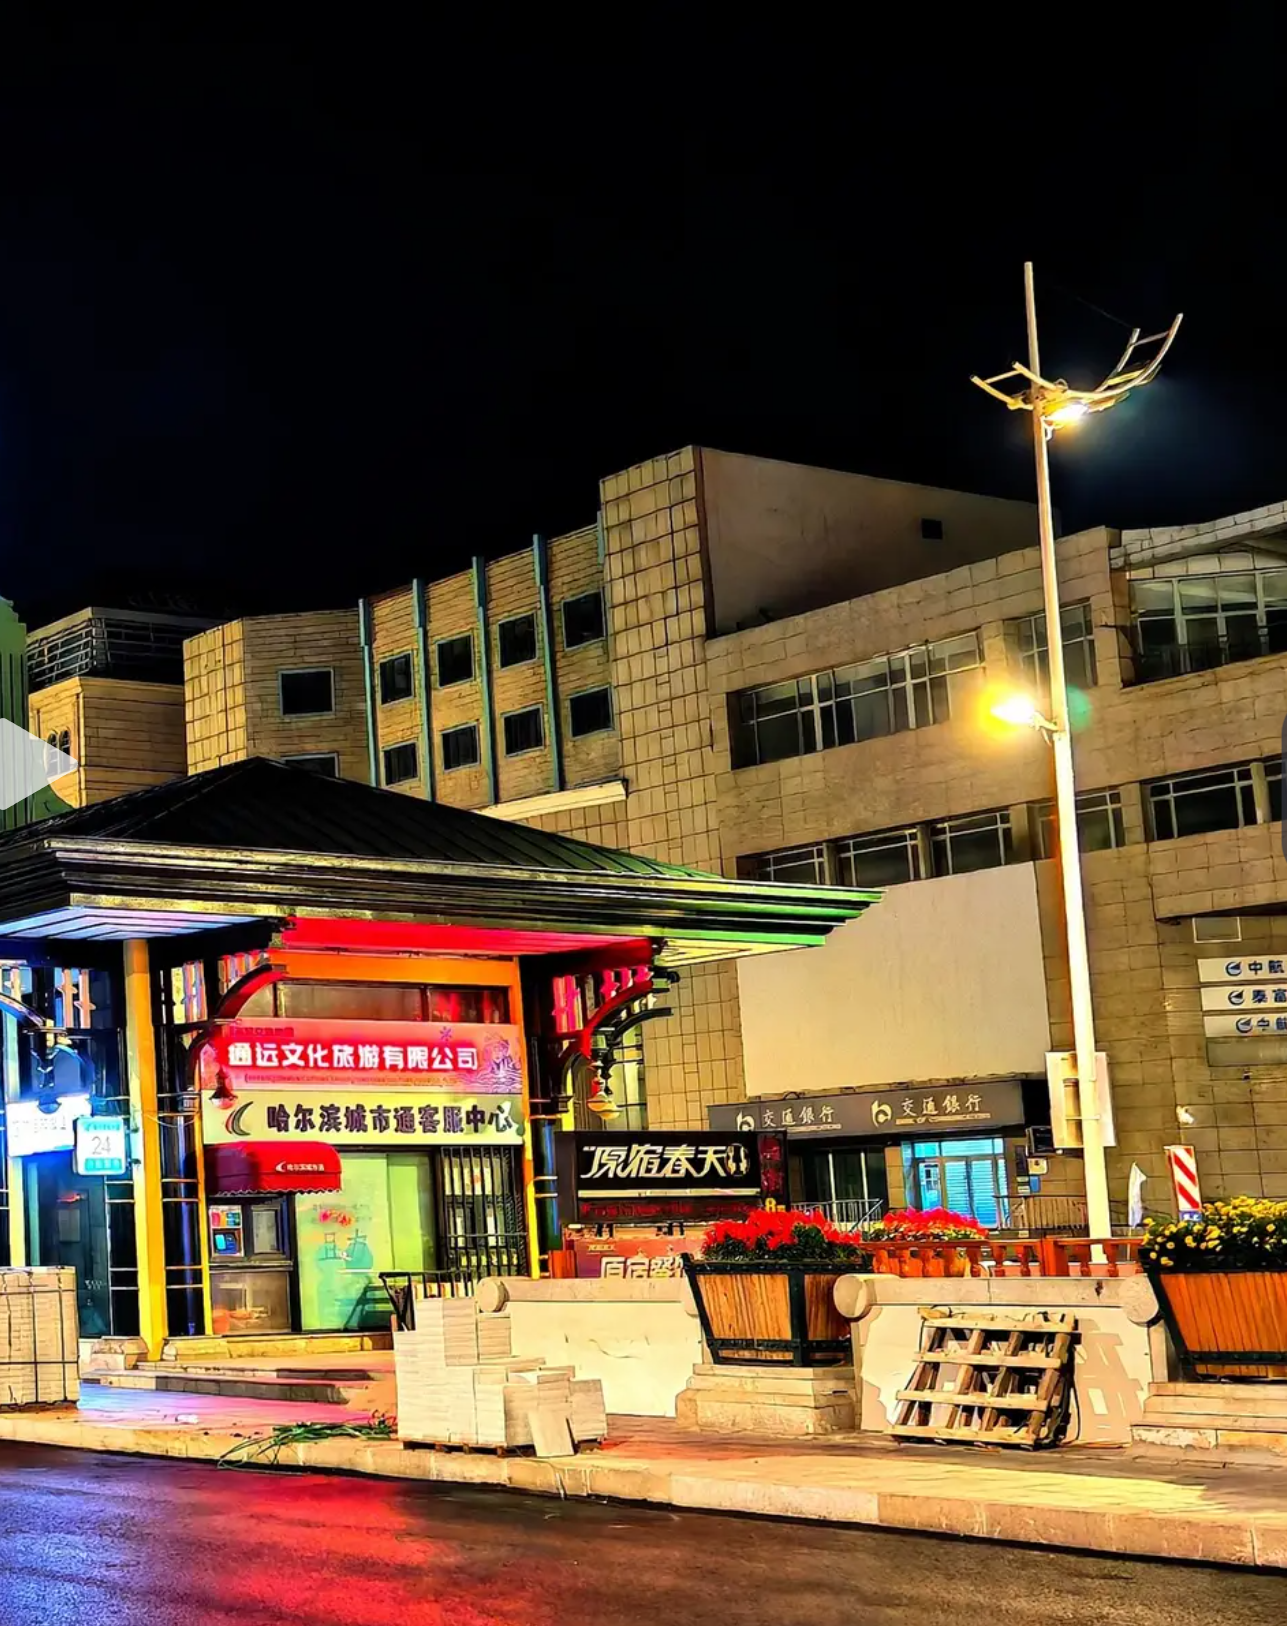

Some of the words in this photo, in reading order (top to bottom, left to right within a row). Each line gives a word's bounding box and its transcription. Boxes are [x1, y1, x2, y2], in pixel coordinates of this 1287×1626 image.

[228, 1042, 478, 1071] 通运文化旅游有限公司
[267, 1103, 513, 1134] 哈尔滨城市通客服中心
[91, 1135, 111, 1155] 24
